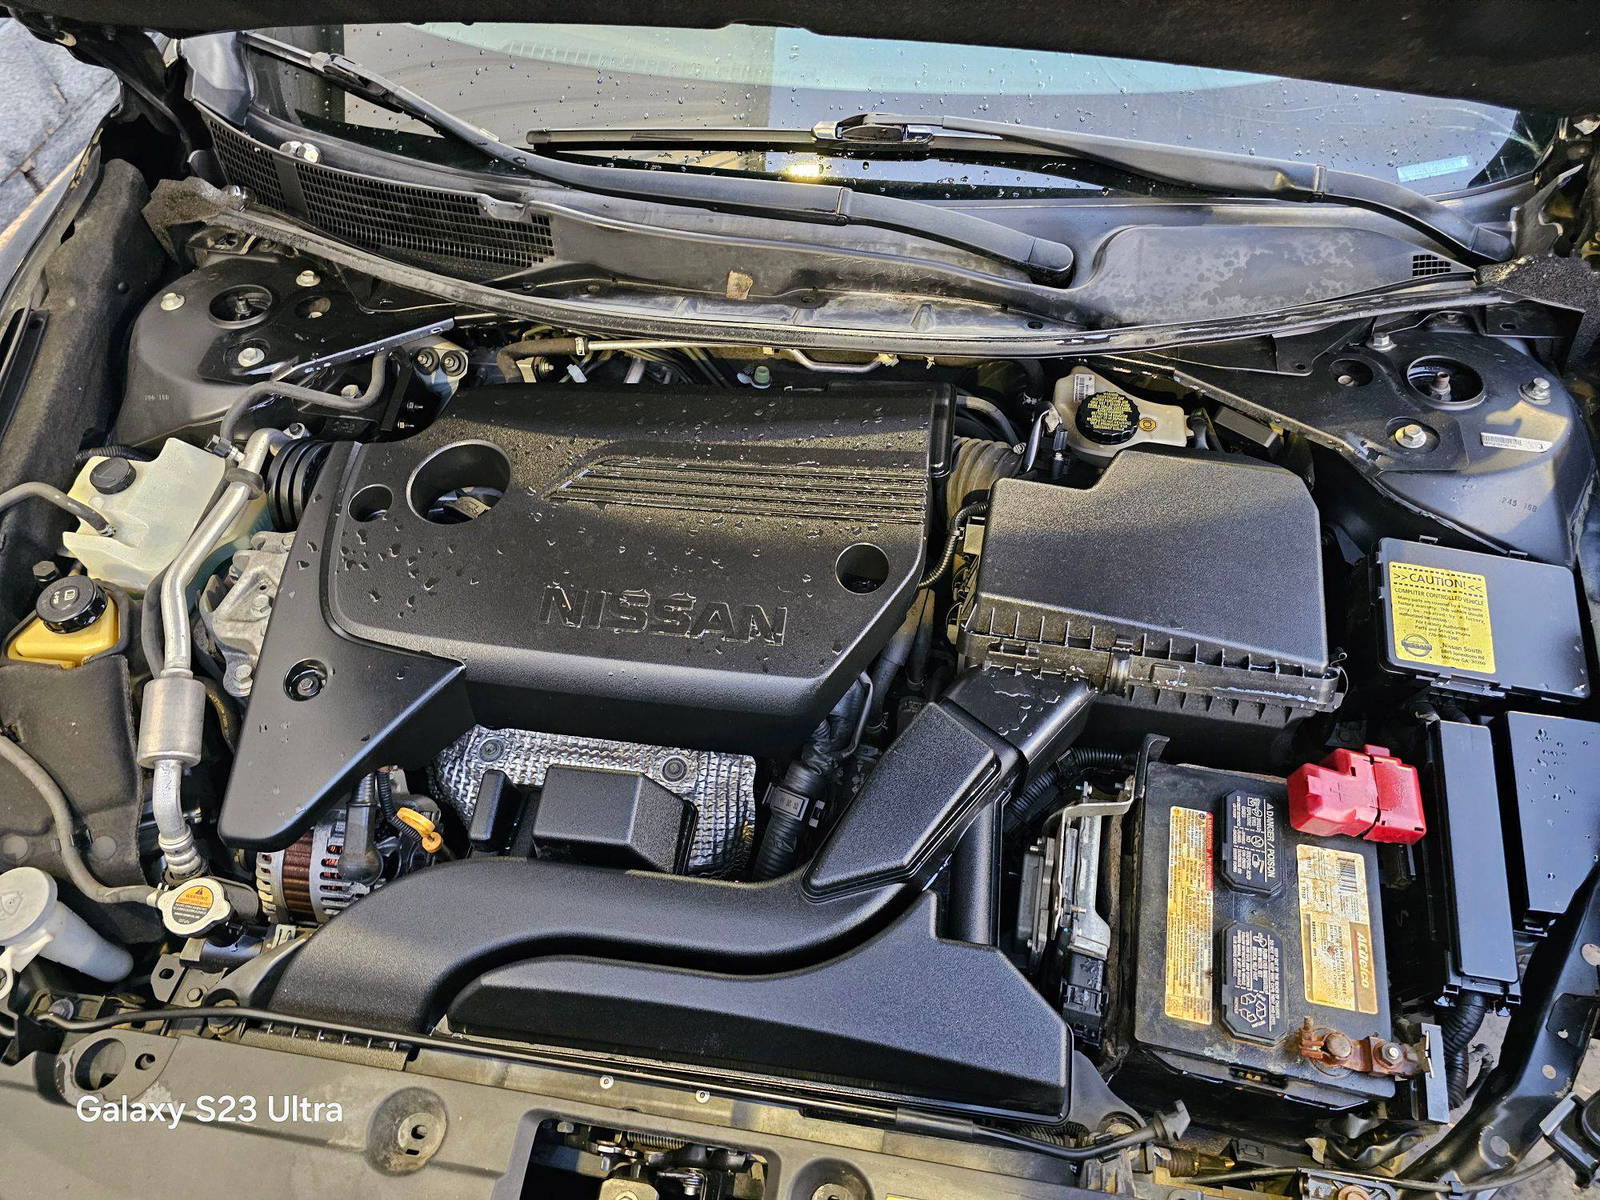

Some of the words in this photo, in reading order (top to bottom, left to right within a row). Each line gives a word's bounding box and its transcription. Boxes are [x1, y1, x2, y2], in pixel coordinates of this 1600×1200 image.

[1395, 588, 1425, 597] COMPUTER
[1426, 592, 1462, 601] CONTROLLED
[1464, 597, 1484, 605] VEHICLE
[538, 582, 788, 647] NISSAN
[1464, 645, 1482, 654] South
[1267, 849, 1275, 878] POISON
[1357, 932, 1370, 989] ACDelco
